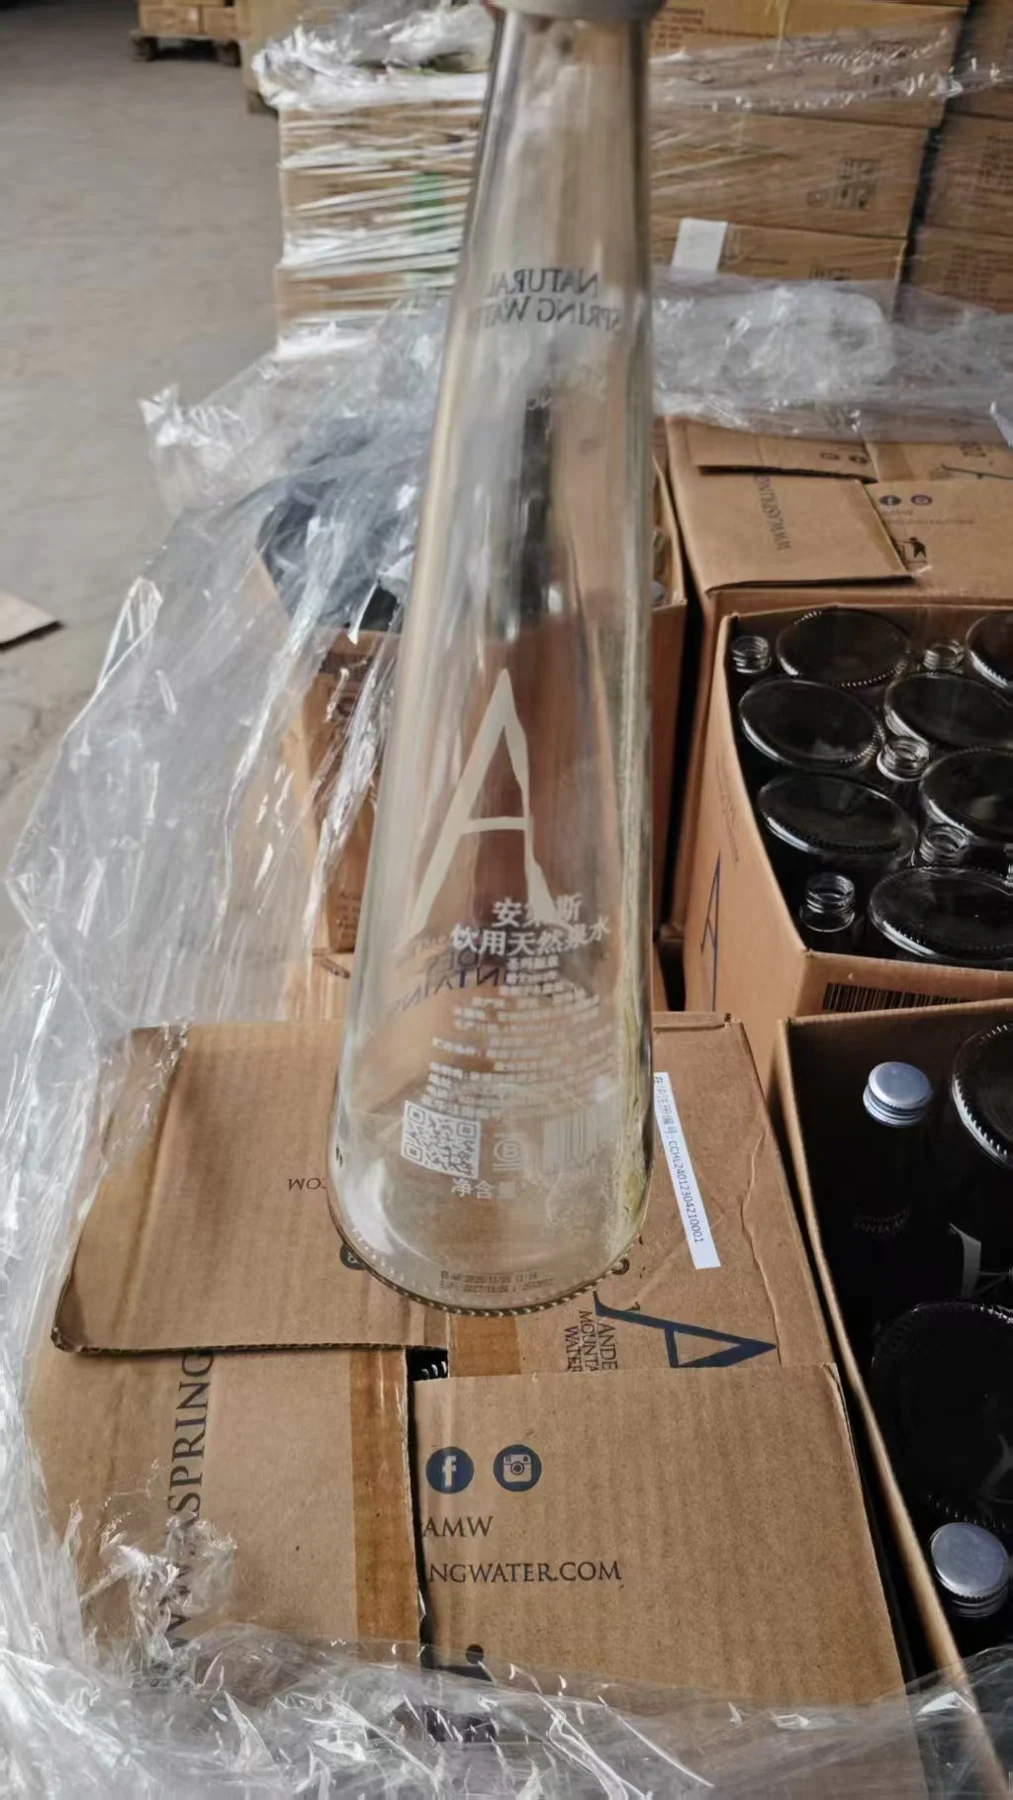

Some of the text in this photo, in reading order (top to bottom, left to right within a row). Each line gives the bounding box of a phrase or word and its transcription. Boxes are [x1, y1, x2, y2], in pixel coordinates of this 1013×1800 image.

[597, 1323, 618, 1370] ANDE
[423, 1515, 494, 1538] AMW
[429, 1560, 622, 1584] NGWATER.COM
